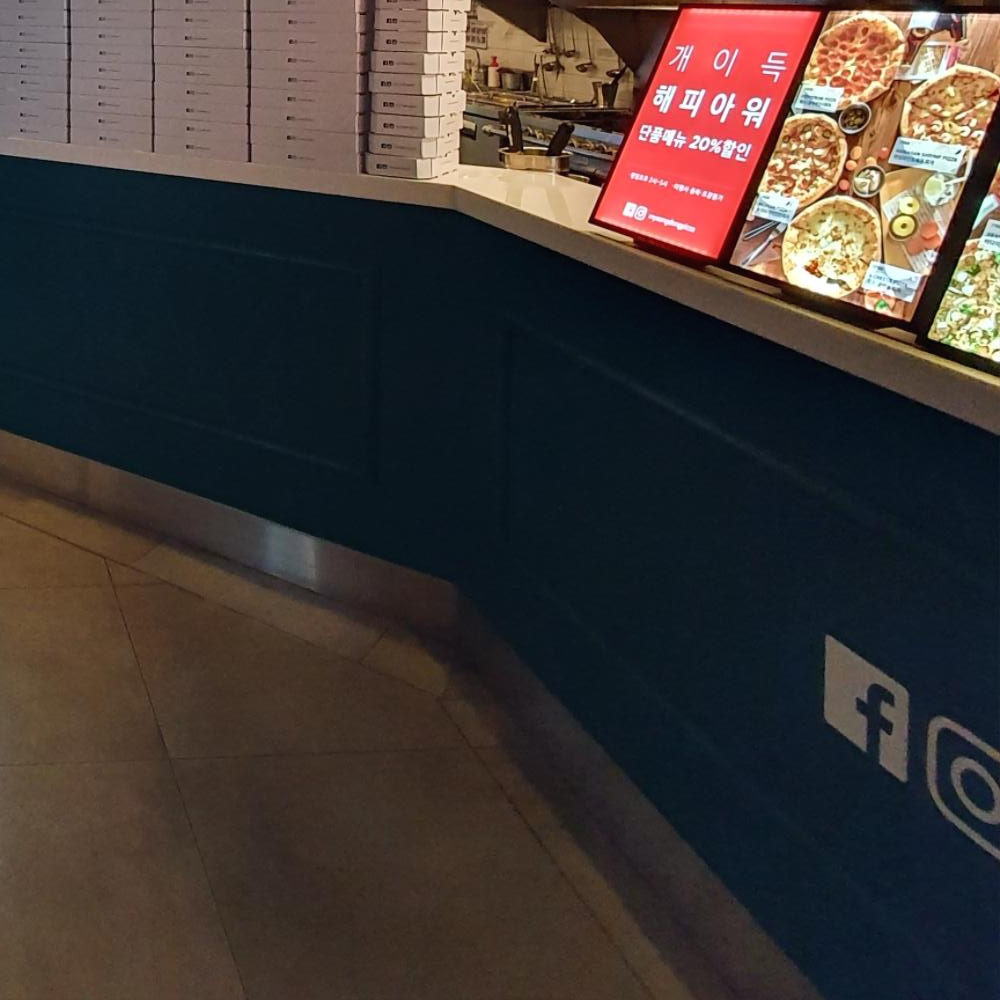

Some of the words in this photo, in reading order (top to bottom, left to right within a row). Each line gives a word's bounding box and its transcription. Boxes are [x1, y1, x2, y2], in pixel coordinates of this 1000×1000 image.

[652, 84, 771, 129] 해피아워
[638, 124, 687, 149] 단품메뉴
[688, 134, 752, 162] 20%할인
